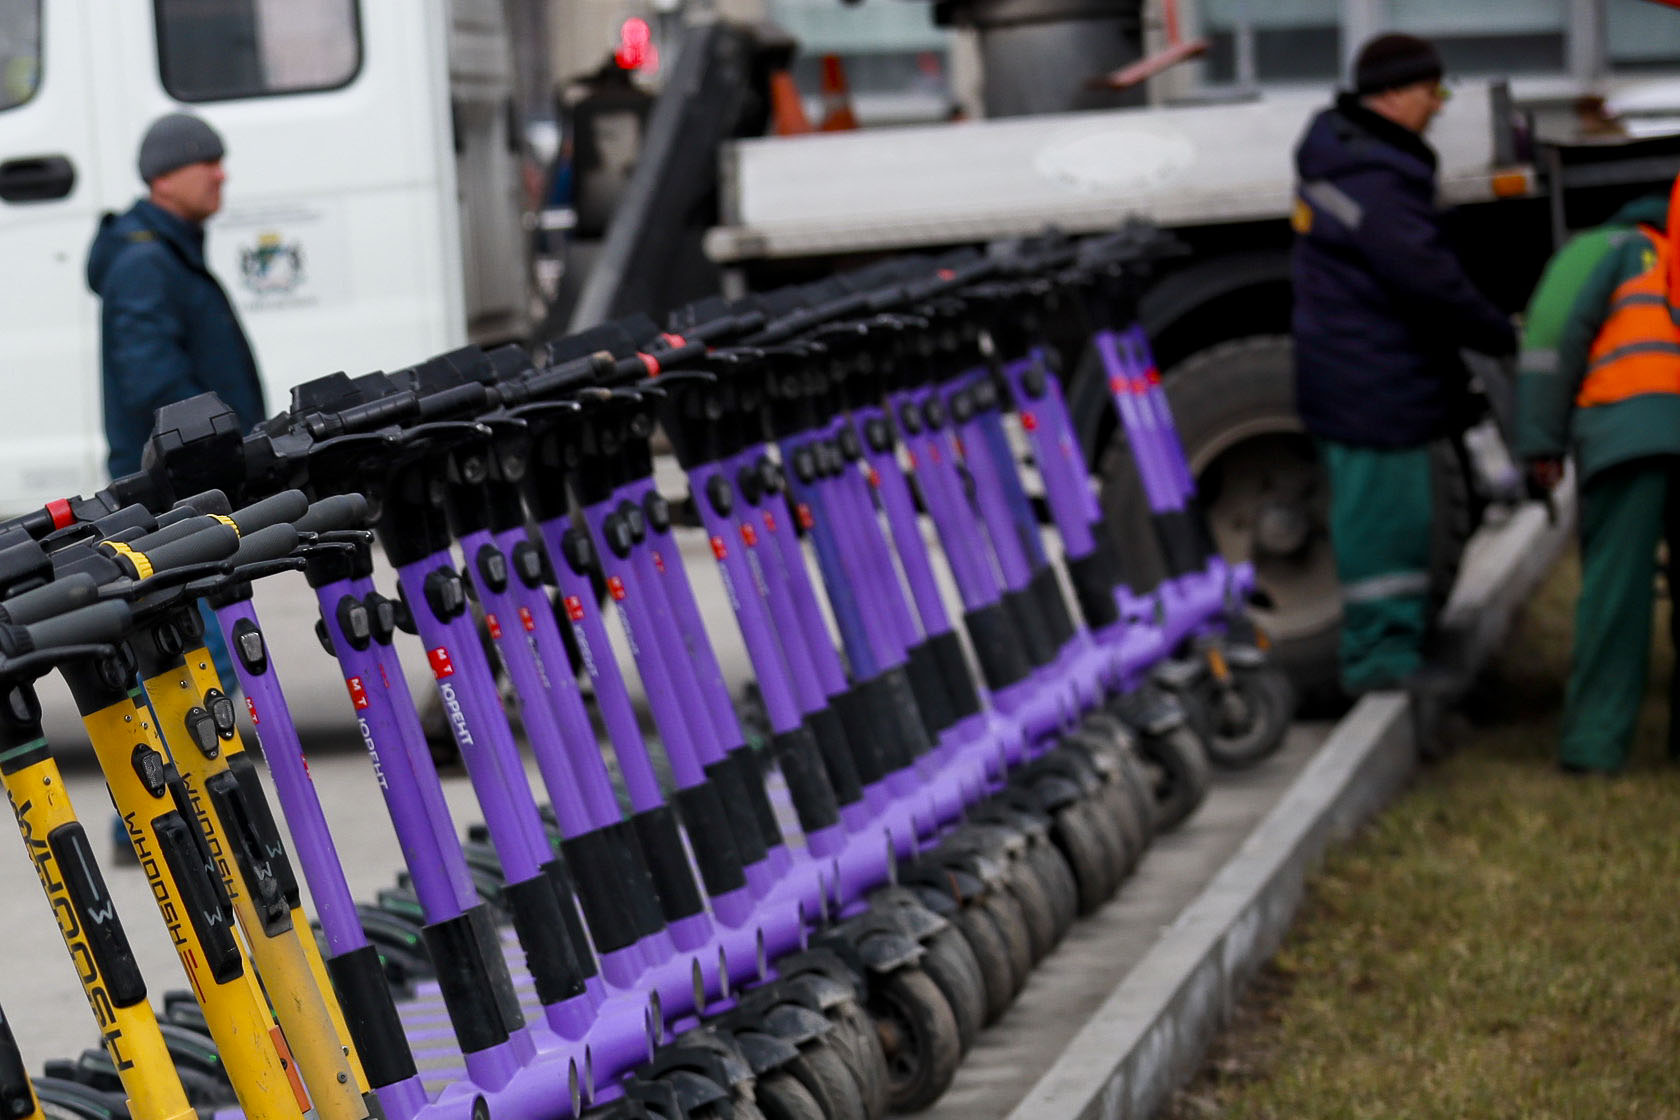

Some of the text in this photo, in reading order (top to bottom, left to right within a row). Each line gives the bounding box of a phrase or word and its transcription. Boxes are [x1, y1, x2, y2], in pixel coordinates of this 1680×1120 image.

[441, 683, 473, 744] ЮРЕНТ
[123, 811, 188, 946] WHOOSH
[182, 772, 239, 898] WHOOSH
[17, 800, 135, 1072] WHOOSH
